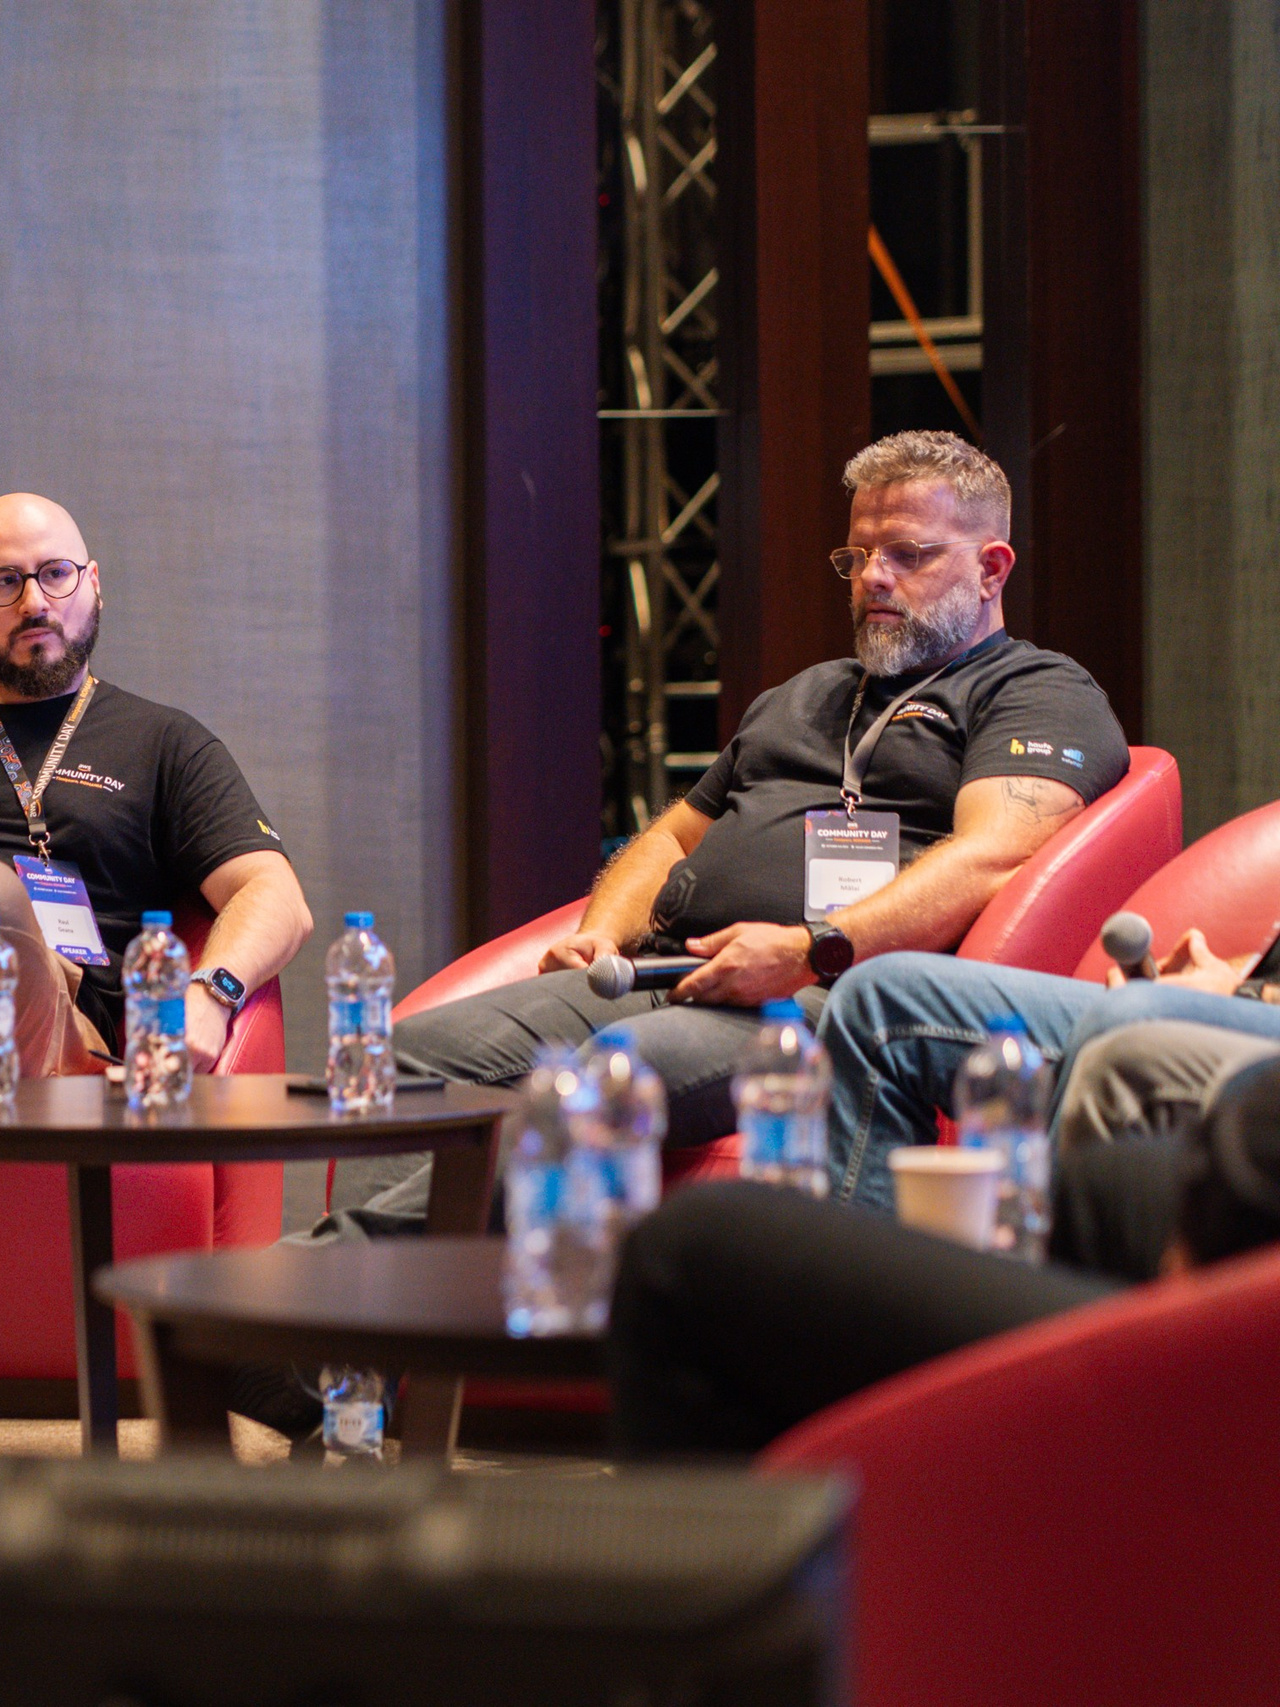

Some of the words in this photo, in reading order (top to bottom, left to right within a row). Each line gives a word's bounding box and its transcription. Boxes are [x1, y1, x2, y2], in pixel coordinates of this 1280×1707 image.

[1027, 747, 1052, 756] group
[32, 741, 66, 800] COMMUNITY
[61, 723, 76, 741] DAY
[55, 769, 103, 784] MMUNITY
[104, 777, 125, 791] DAY
[817, 829, 869, 838] COMMUNITY
[870, 831, 888, 839] DAY
[26, 872, 62, 883] COMMUNITY
